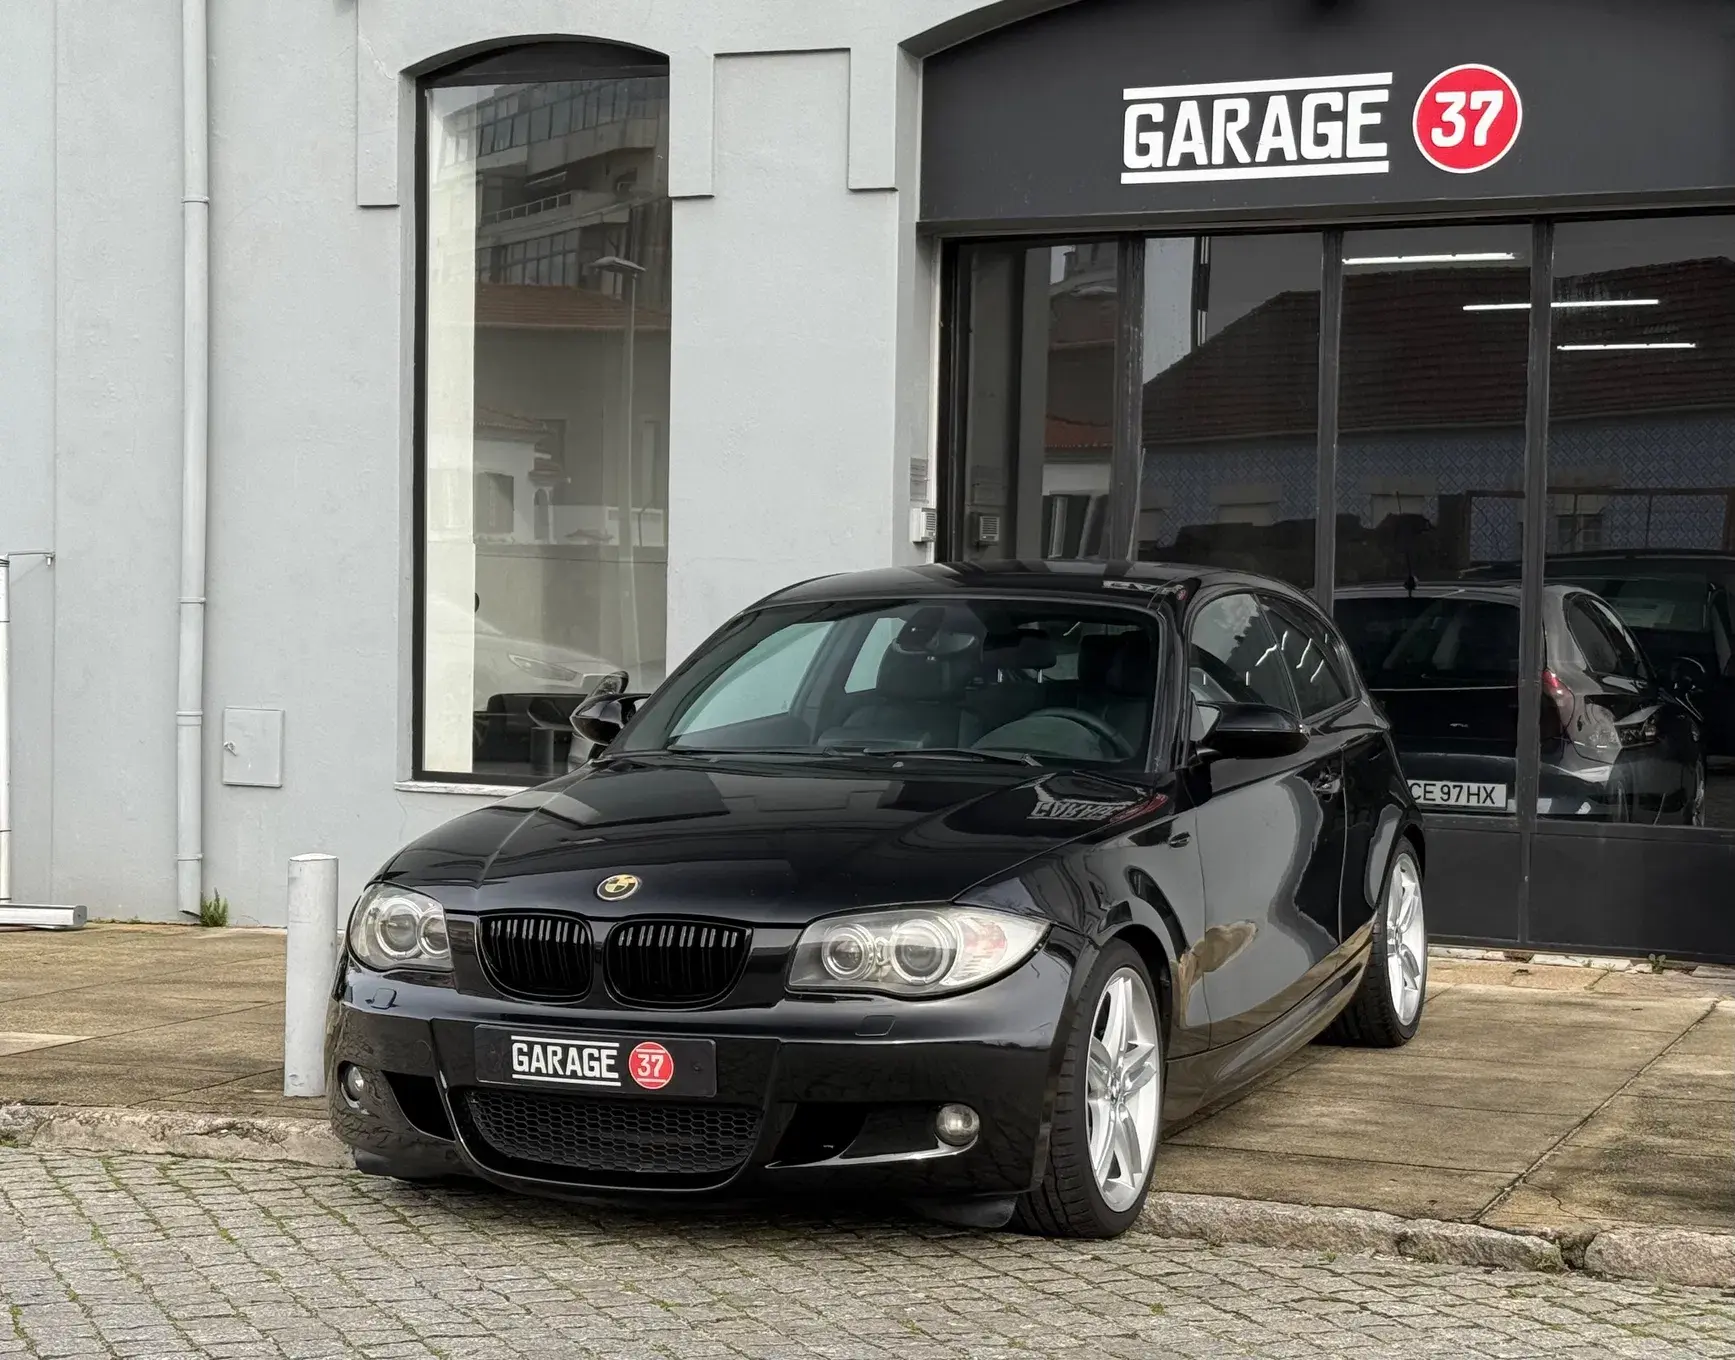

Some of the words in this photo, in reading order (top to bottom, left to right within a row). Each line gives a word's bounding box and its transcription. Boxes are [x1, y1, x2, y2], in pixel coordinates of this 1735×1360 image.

[1123, 90, 1390, 169] GARAGE
[1430, 91, 1504, 147] 37
[1411, 782, 1436, 801] CE
[1440, 784, 1463, 803] 97
[1466, 786, 1496, 804] HX
[512, 1043, 619, 1079] GARAGE
[637, 1054, 664, 1077] 37
